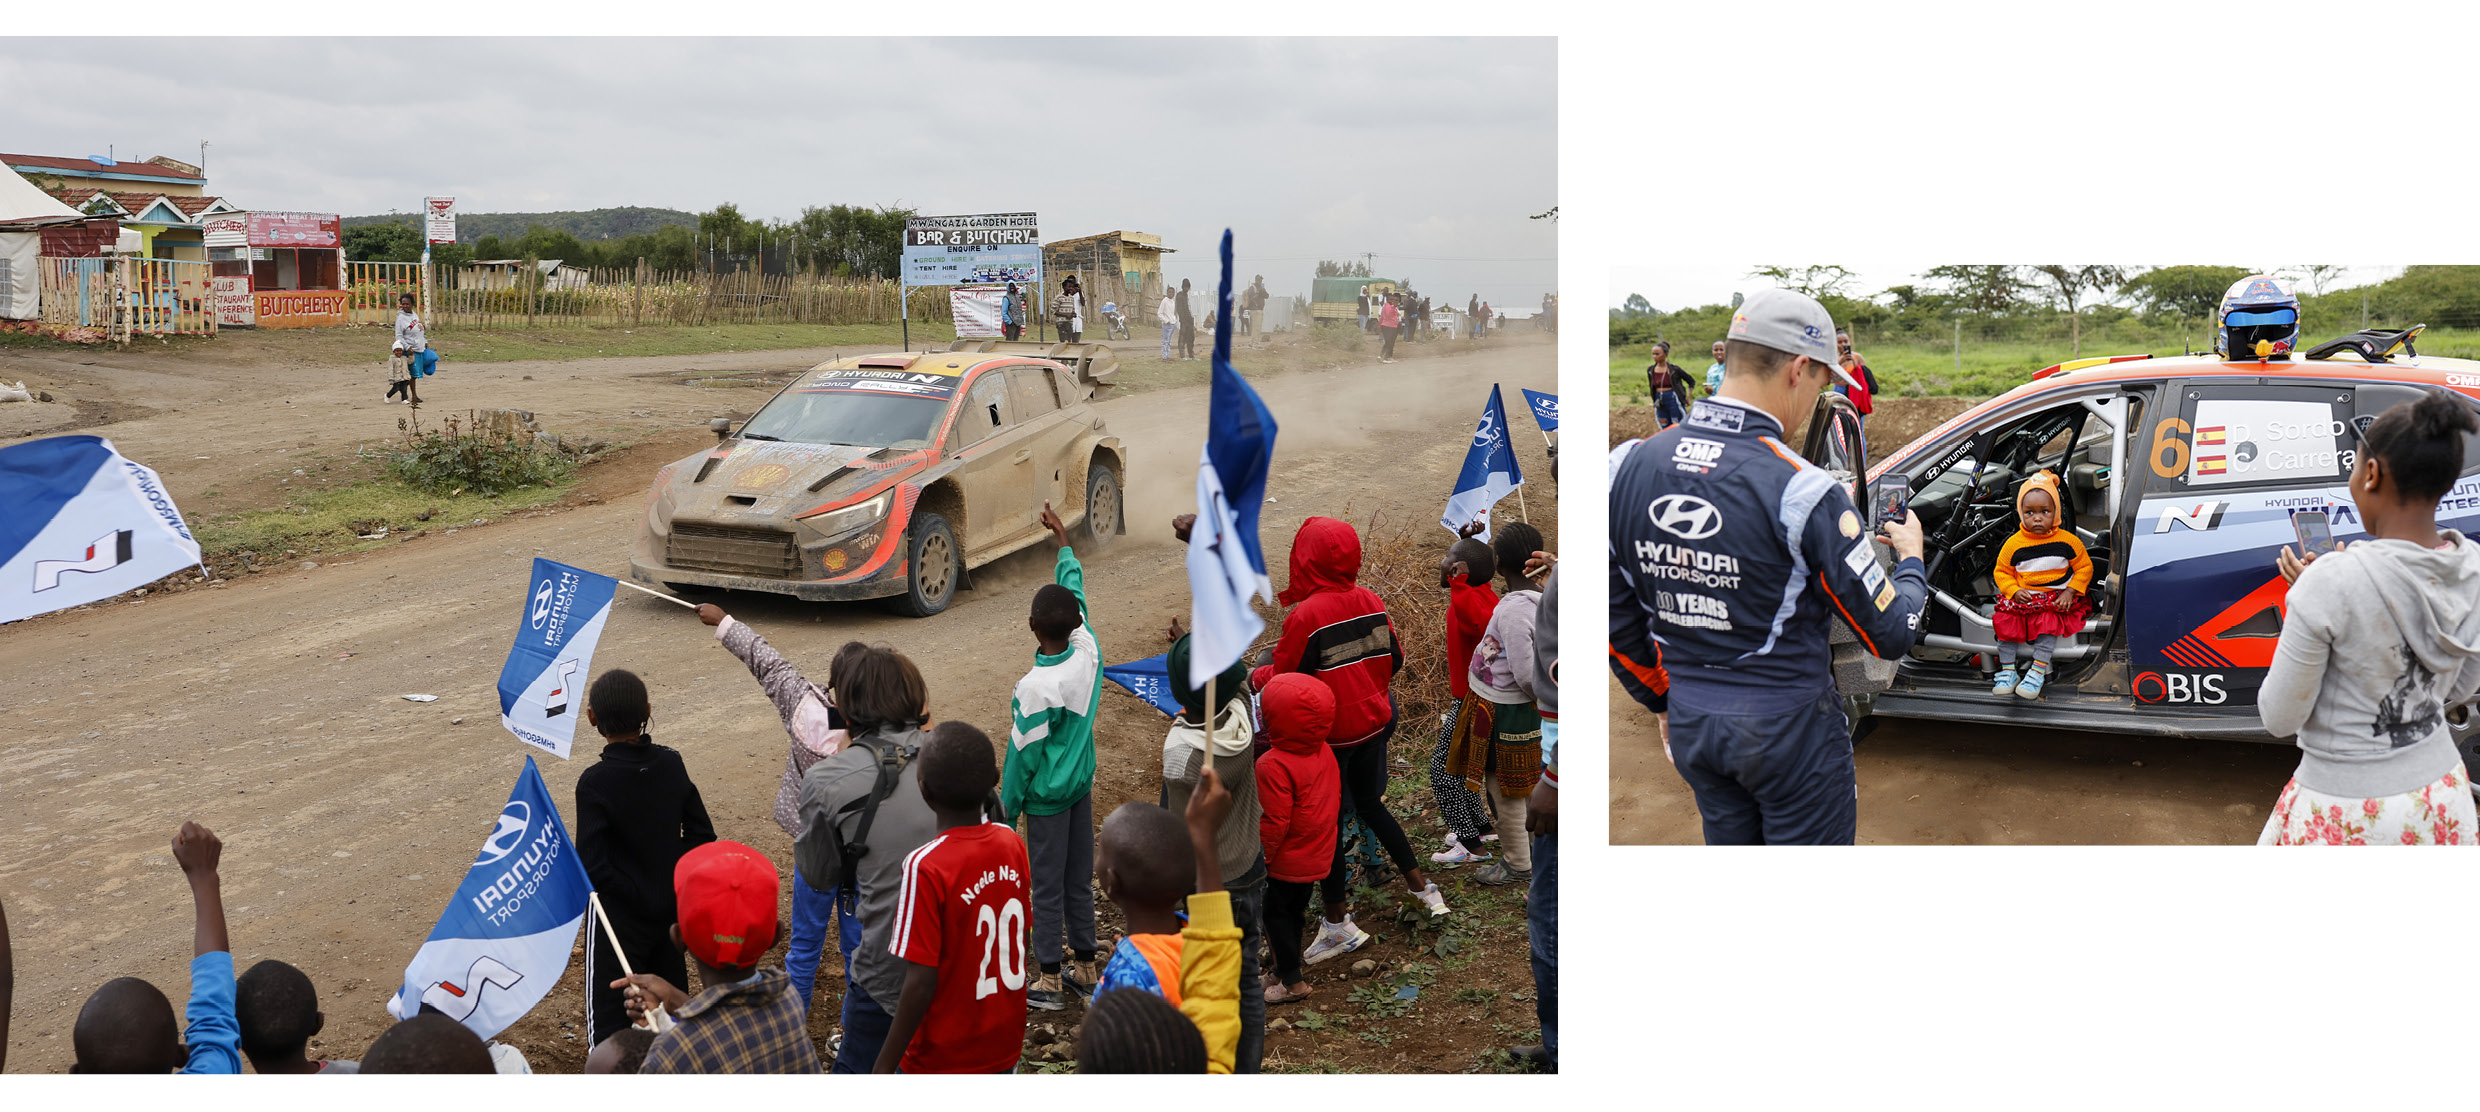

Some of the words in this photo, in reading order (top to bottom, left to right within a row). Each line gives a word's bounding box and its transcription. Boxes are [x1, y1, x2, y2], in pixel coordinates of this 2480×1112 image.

[289, 213, 307, 221] MEAT
[910, 219, 968, 228] MWANGAZA
[969, 218, 1007, 227] GARDEN
[1010, 217, 1037, 226] HOTEL
[917, 231, 944, 245] BAR
[949, 231, 961, 245] &
[967, 229, 1030, 245] BUTCHERY
[947, 245, 980, 253] ENQUIRE
[987, 244, 998, 252] ON
[260, 296, 346, 318] BUTCHERY
[223, 313, 243, 323] HALL
[844, 370, 907, 379] HYUNDAI
[860, 382, 909, 390] RALLY
[2047, 416, 2073, 437] HYUNDAI
[2233, 424, 2258, 445] D.
[2266, 417, 2346, 442] Sordo
[1675, 442, 1723, 462] OMP
[1939, 439, 1975, 469] HYUNDAI
[2150, 417, 2192, 479] 6
[2233, 452, 2258, 474] C.
[2265, 449, 2356, 472] Carrera
[2265, 496, 2325, 507] HYUNDAI
[1634, 540, 1740, 574] HYUNDAI
[1675, 593, 1729, 620] YEARS
[1500, 733, 1518, 741] TABIA
[960, 870, 995, 906] Neele
[975, 897, 1026, 1001] 20
